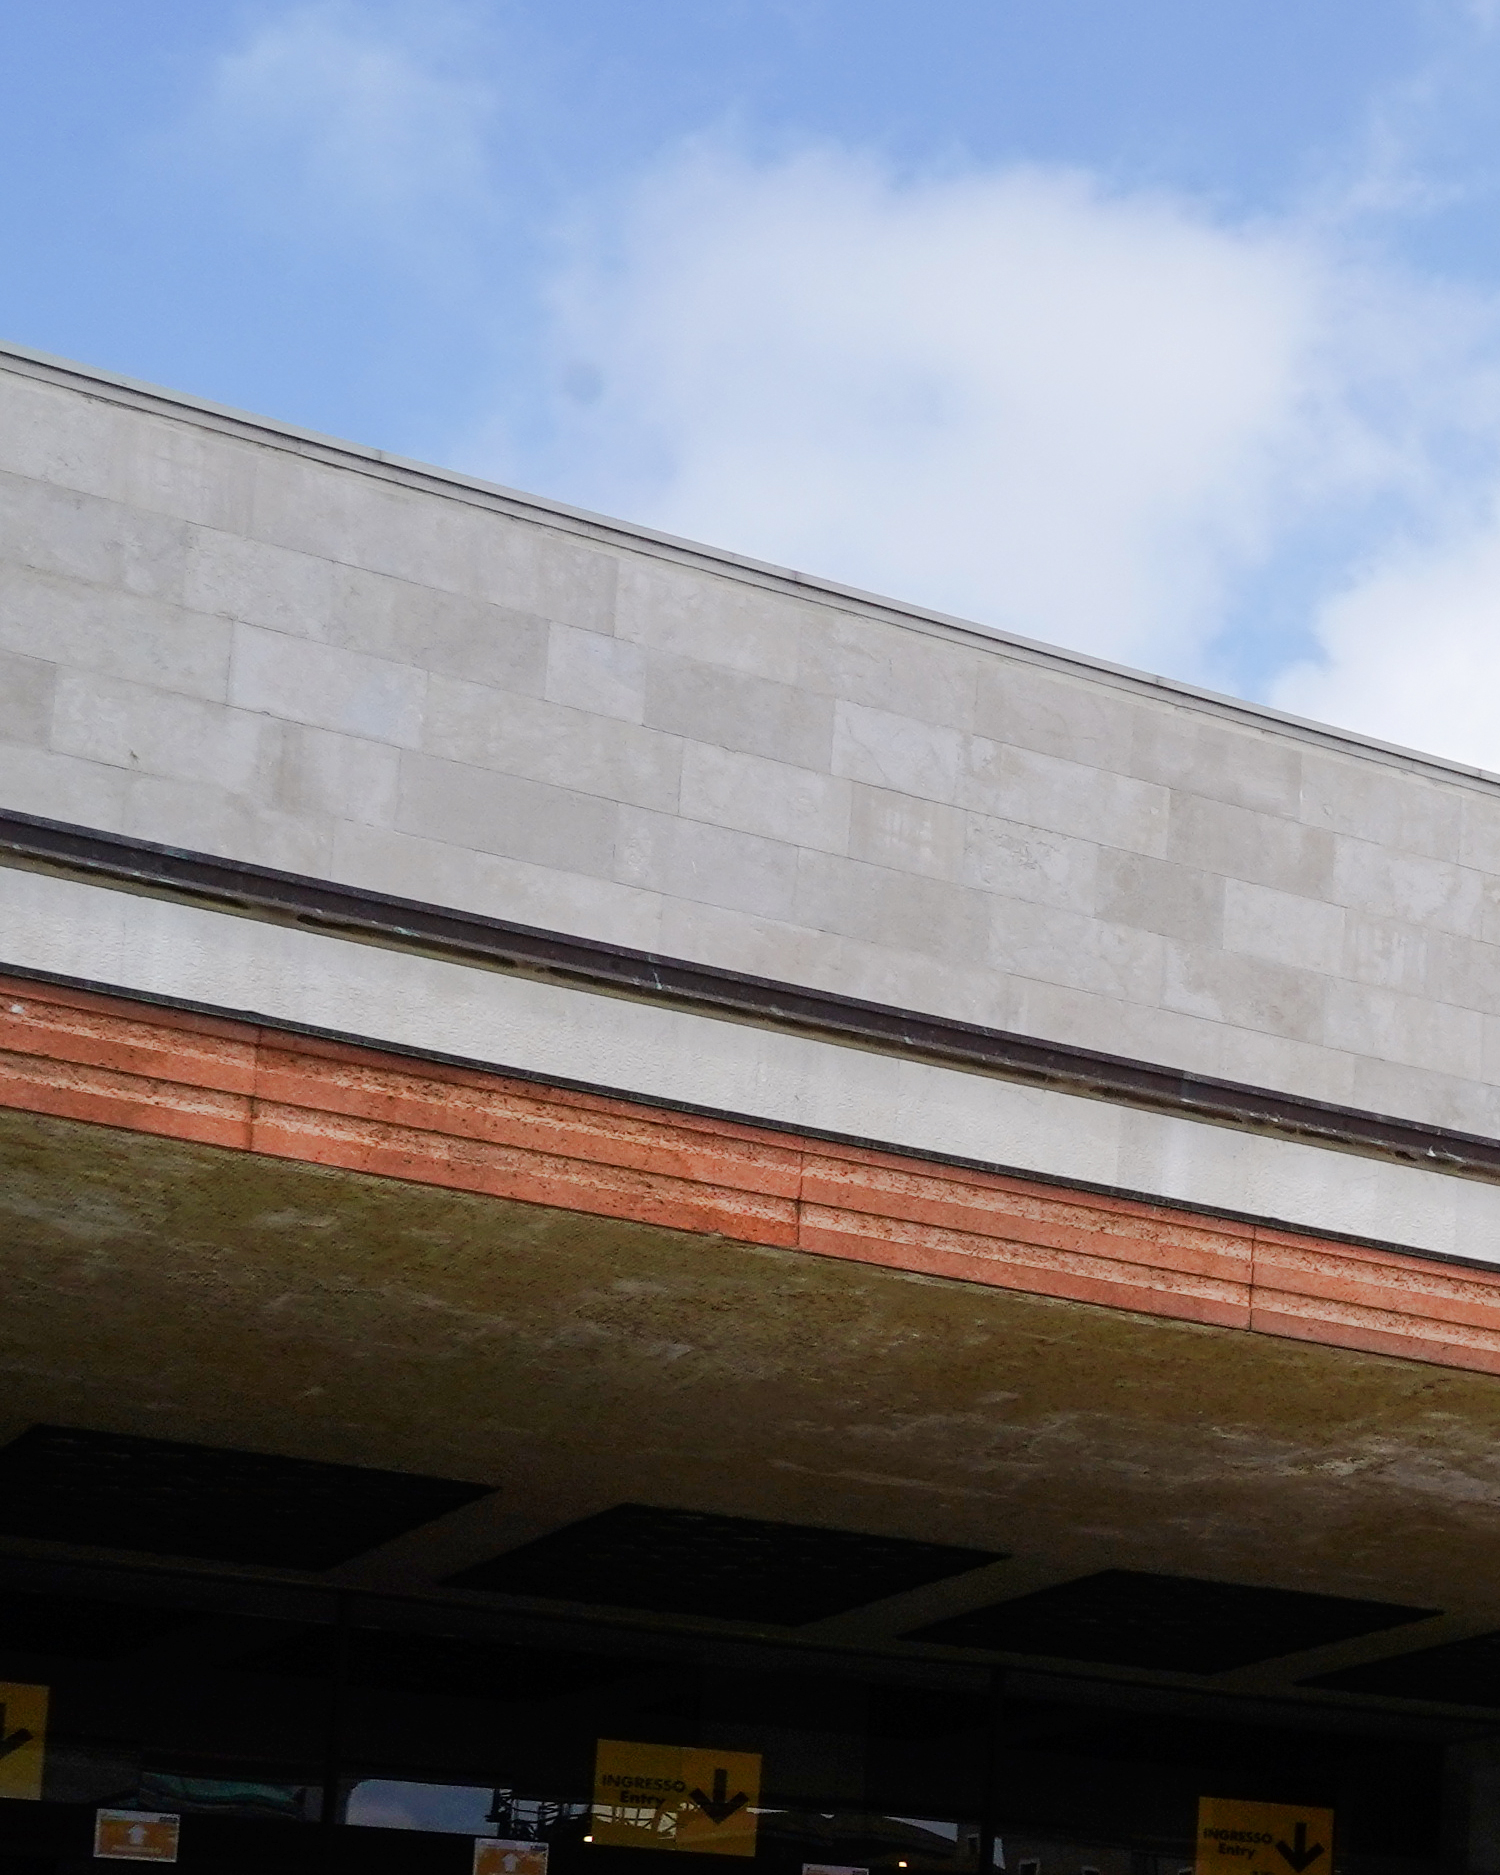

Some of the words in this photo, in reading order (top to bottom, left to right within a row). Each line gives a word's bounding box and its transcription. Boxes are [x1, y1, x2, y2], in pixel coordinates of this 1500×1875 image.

[602, 1773, 685, 1794] INGRESSO
[619, 1790, 665, 1808] Entry
[1203, 1826, 1273, 1845] INGRESSO
[1218, 1842, 1255, 1859] Entry
